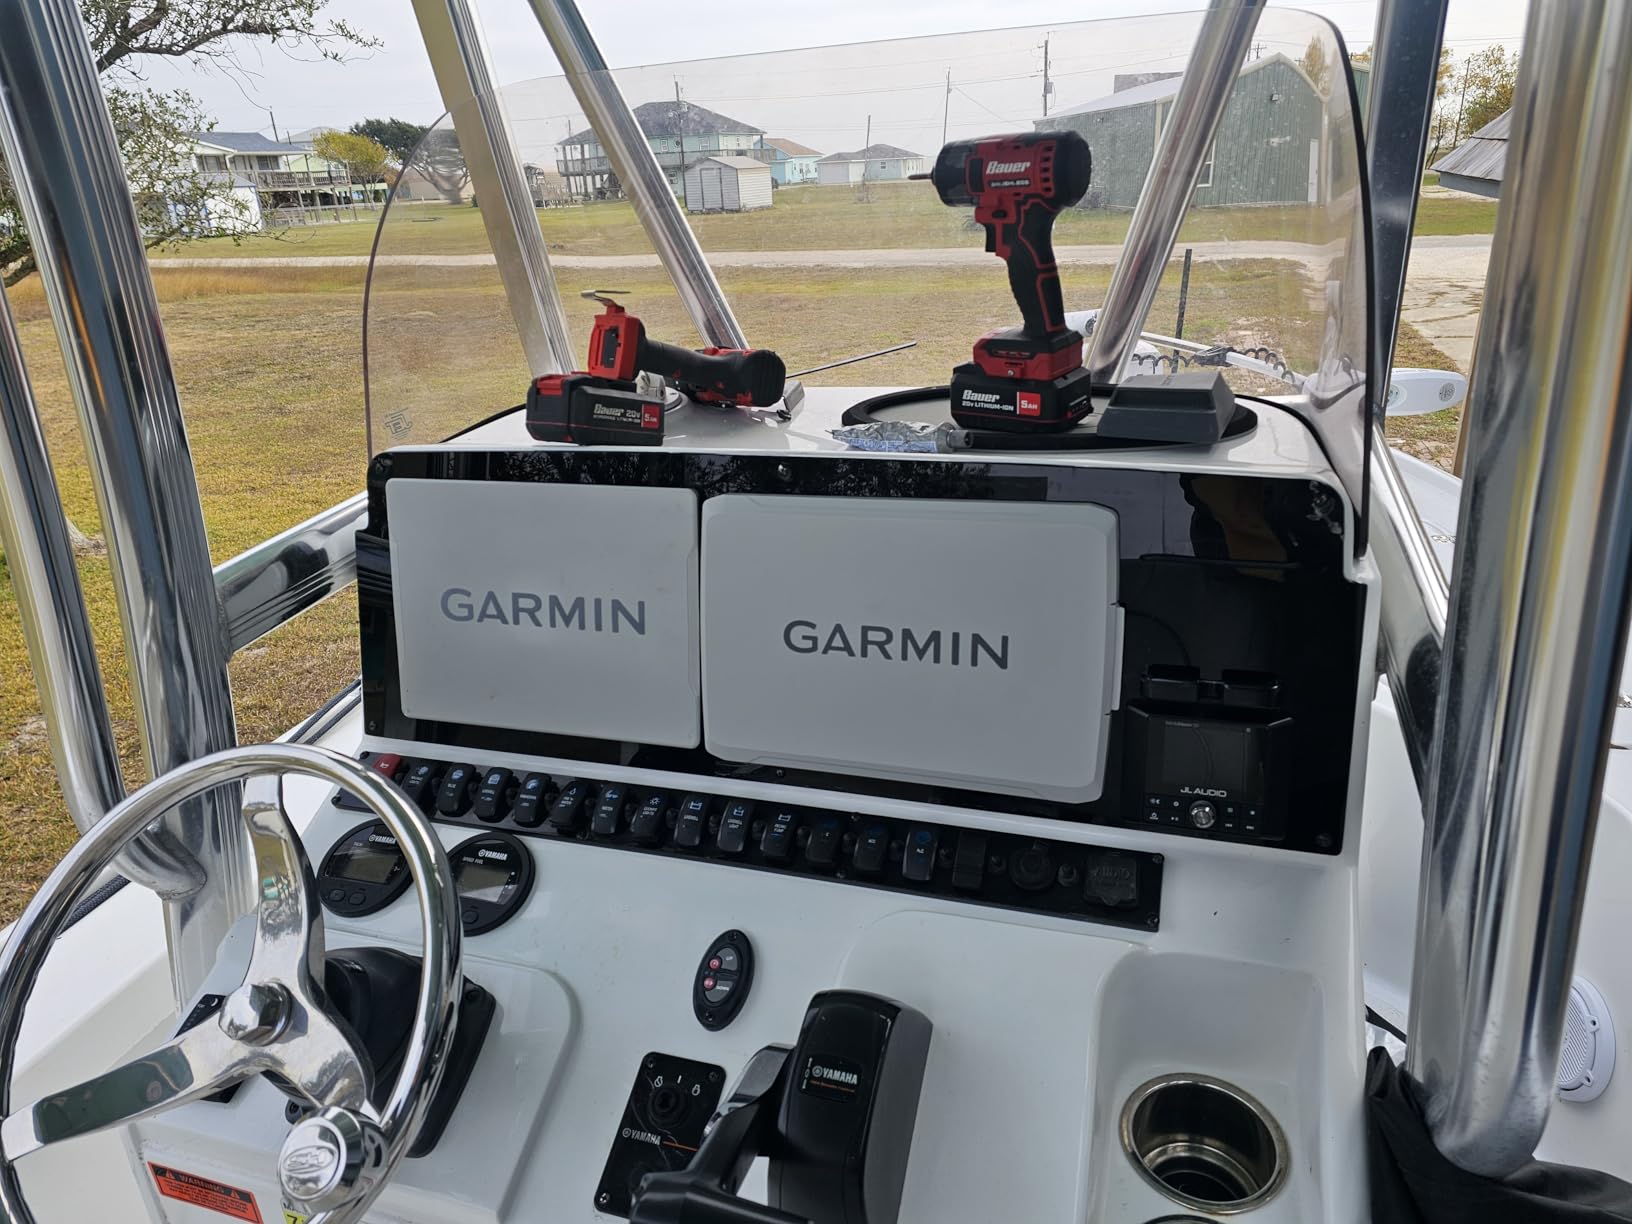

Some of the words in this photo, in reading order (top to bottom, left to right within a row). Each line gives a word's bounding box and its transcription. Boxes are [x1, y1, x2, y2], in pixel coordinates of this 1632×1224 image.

[985, 160, 1031, 175] Bauer
[962, 389, 1000, 403] Bauer
[593, 403, 625, 417] Bauer
[440, 587, 646, 636] GARMIN
[783, 619, 1009, 670] GARMIN
[1193, 787, 1228, 798] AUDIO
[485, 850, 508, 861] YAMAHA
[823, 1067, 858, 1085] YAMAHA
[631, 1129, 662, 1146] YAMAHA
[179, 1174, 225, 1194] WARNING
